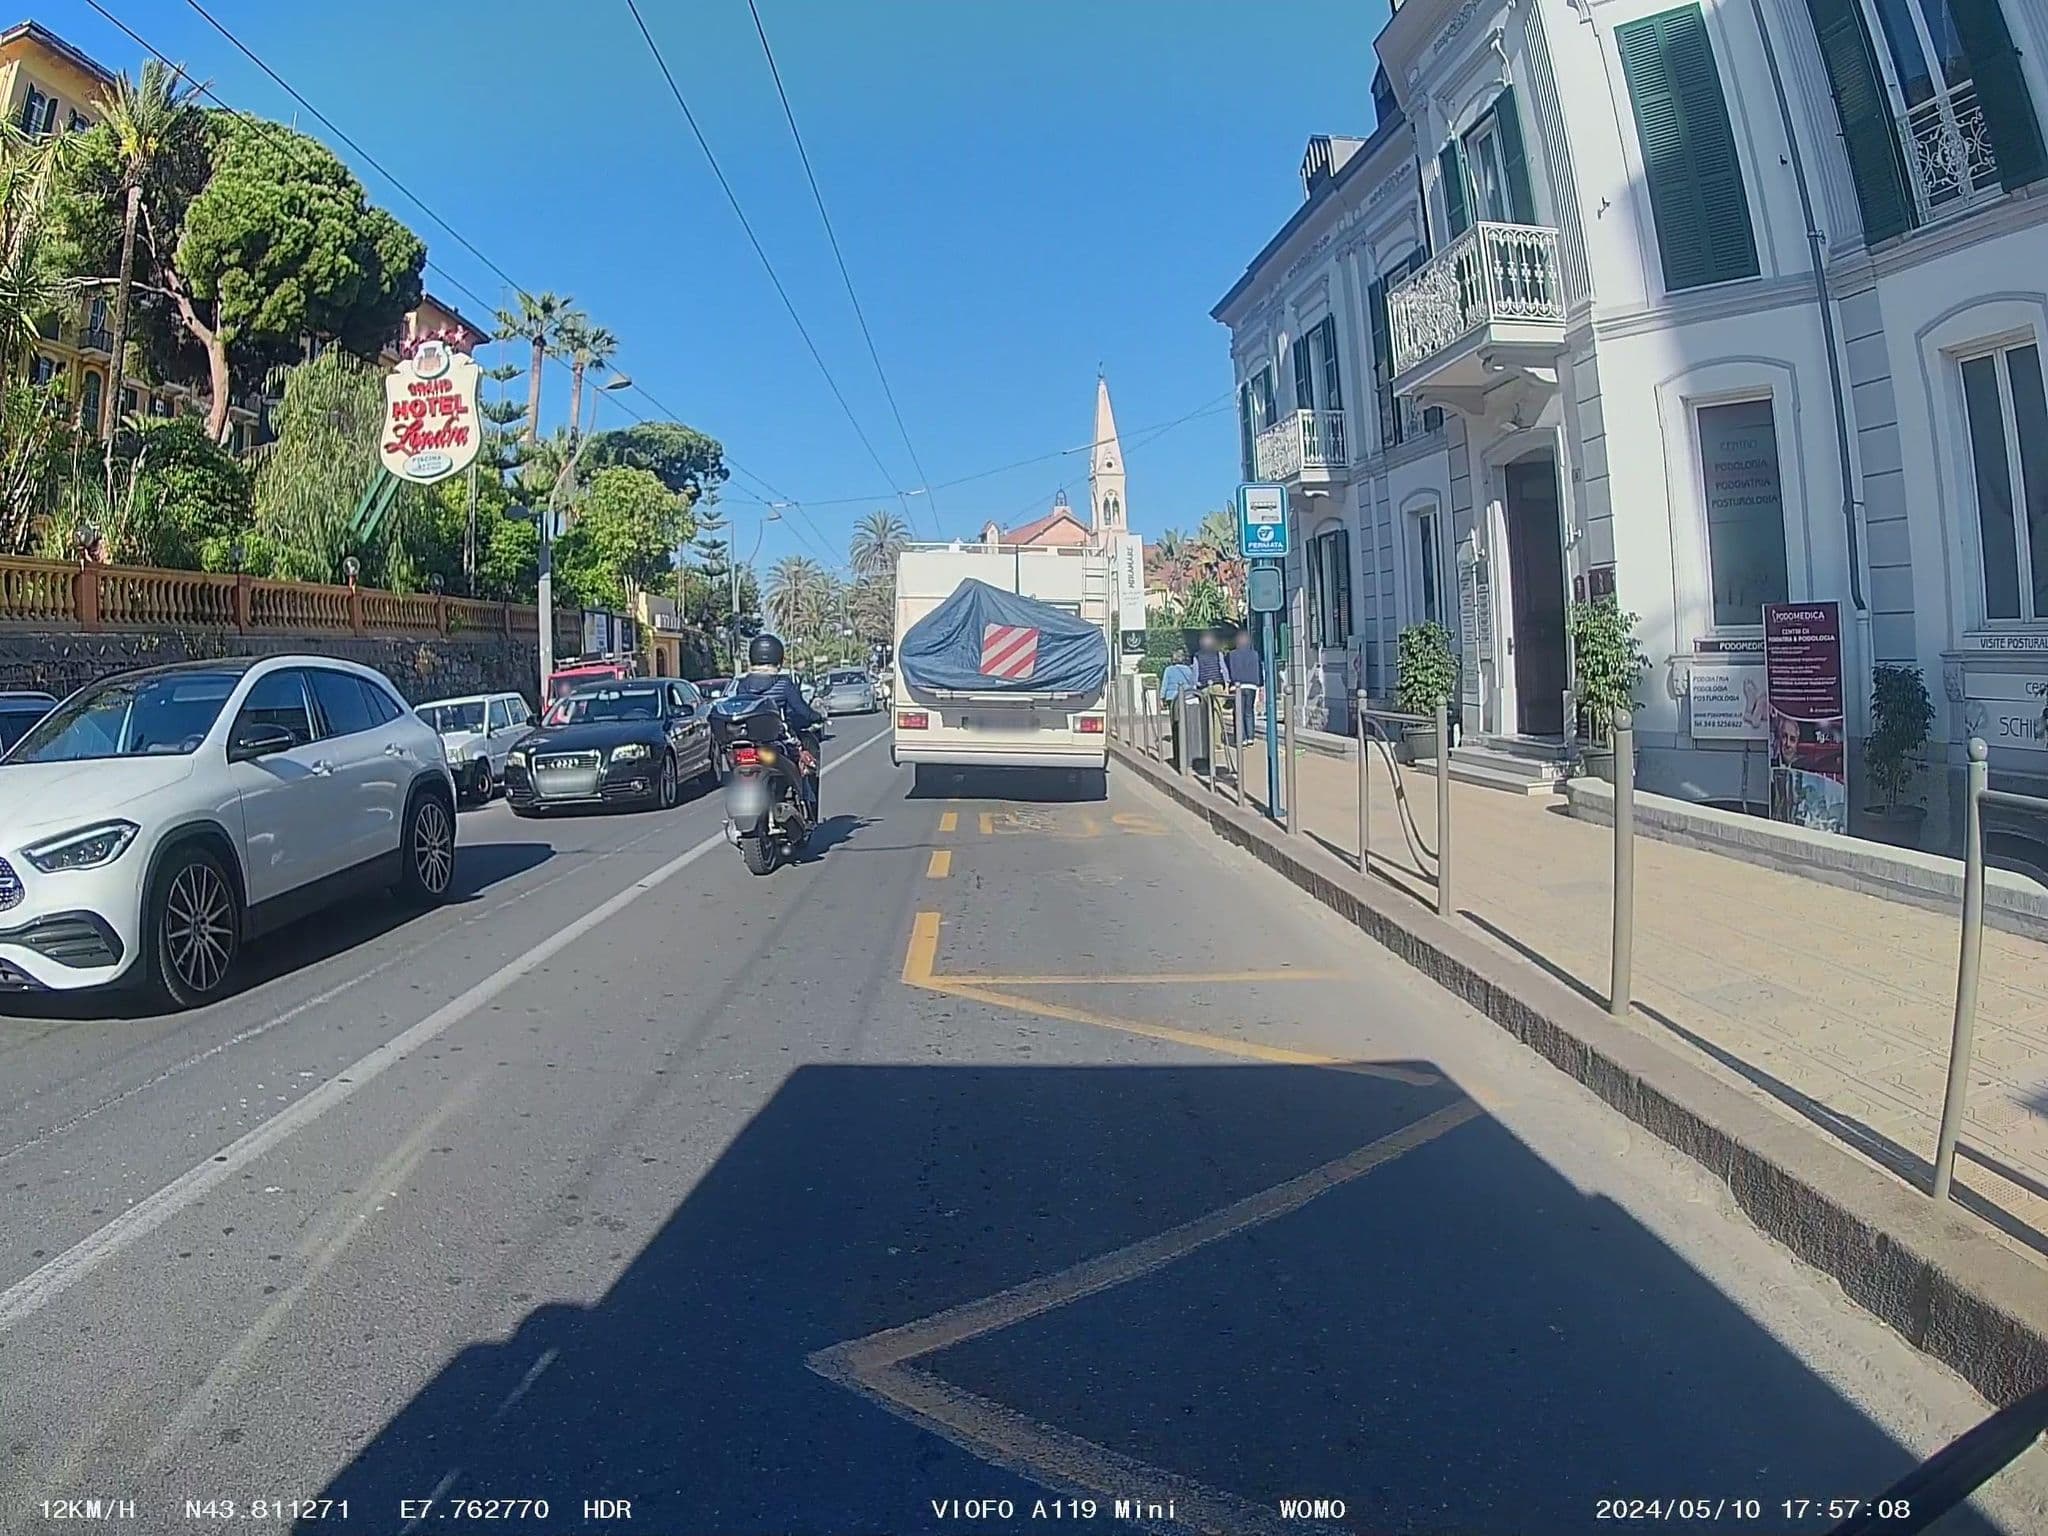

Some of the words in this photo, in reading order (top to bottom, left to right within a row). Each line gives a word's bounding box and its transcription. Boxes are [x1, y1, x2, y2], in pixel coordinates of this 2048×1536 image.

[392, 394, 468, 421] HOTEL
[1247, 541, 1284, 550] FERMATA
[1775, 610, 1826, 621] PODOMEDICA
[1981, 638, 2006, 649] VISITE
